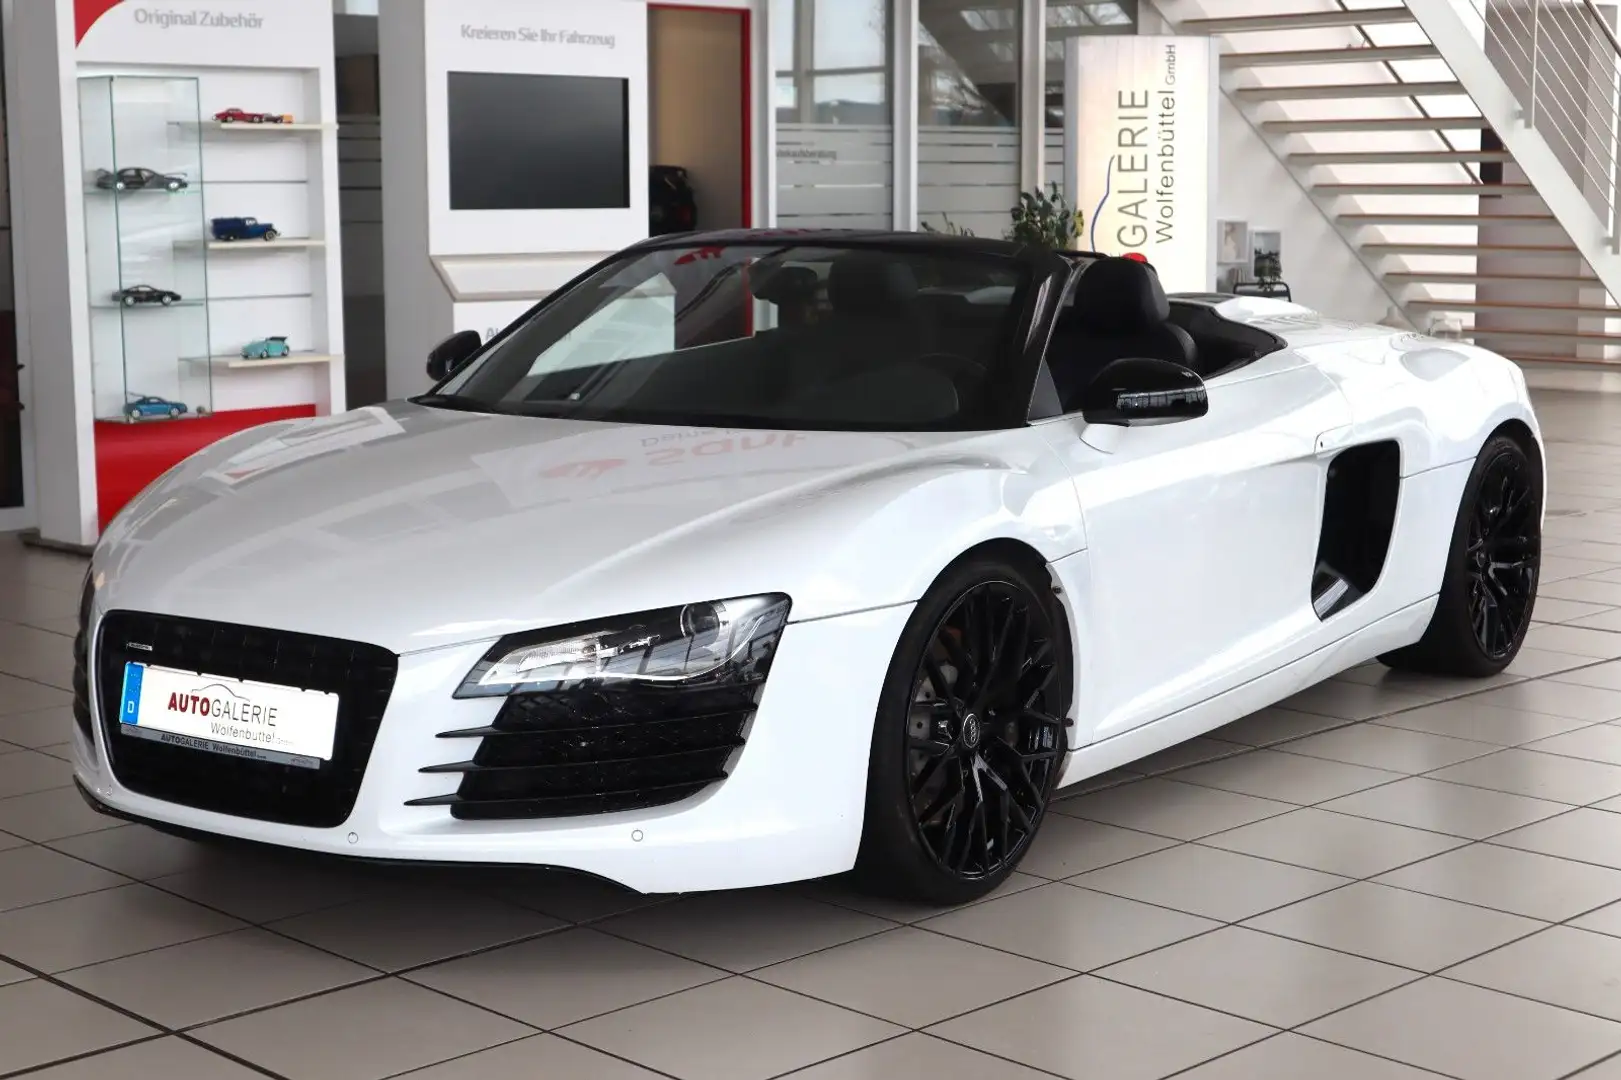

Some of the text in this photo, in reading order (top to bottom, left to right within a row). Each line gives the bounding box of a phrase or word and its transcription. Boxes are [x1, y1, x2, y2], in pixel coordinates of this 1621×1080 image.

[134, 8, 264, 29] Original Zubehör
[461, 24, 616, 49] Kreieren Sie Ihr Fahrzeug
[1156, 44, 1176, 244] Wolfenbüttel GmbH
[127, 701, 135, 714] D
[167, 691, 278, 727] AUTOGALERIE
[161, 733, 209, 750] AUTOGALERIE
[212, 743, 257, 758] Wolfenbüttel
